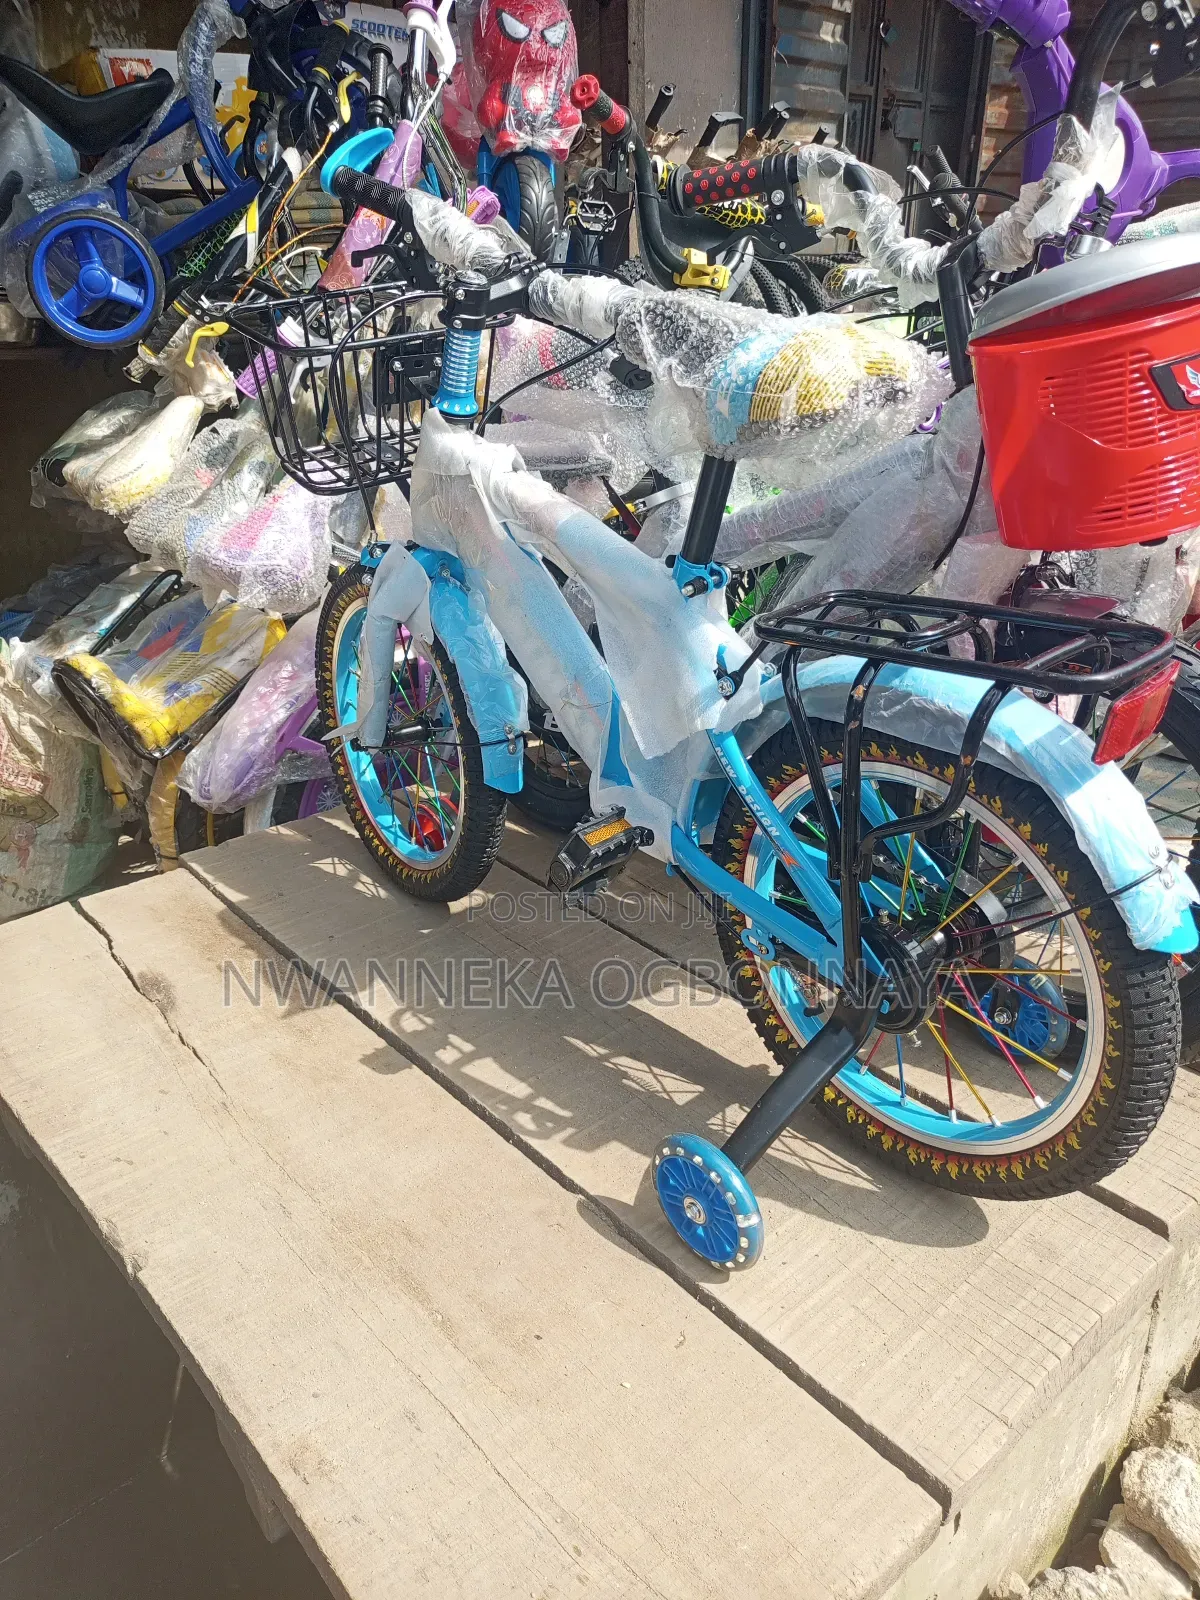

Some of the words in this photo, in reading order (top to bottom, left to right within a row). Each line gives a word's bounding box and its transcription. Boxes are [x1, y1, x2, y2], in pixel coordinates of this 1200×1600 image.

[351, 19, 408, 41] SCOOTER
[714, 746, 737, 778] NEW
[738, 784, 780, 836] DESIGN
